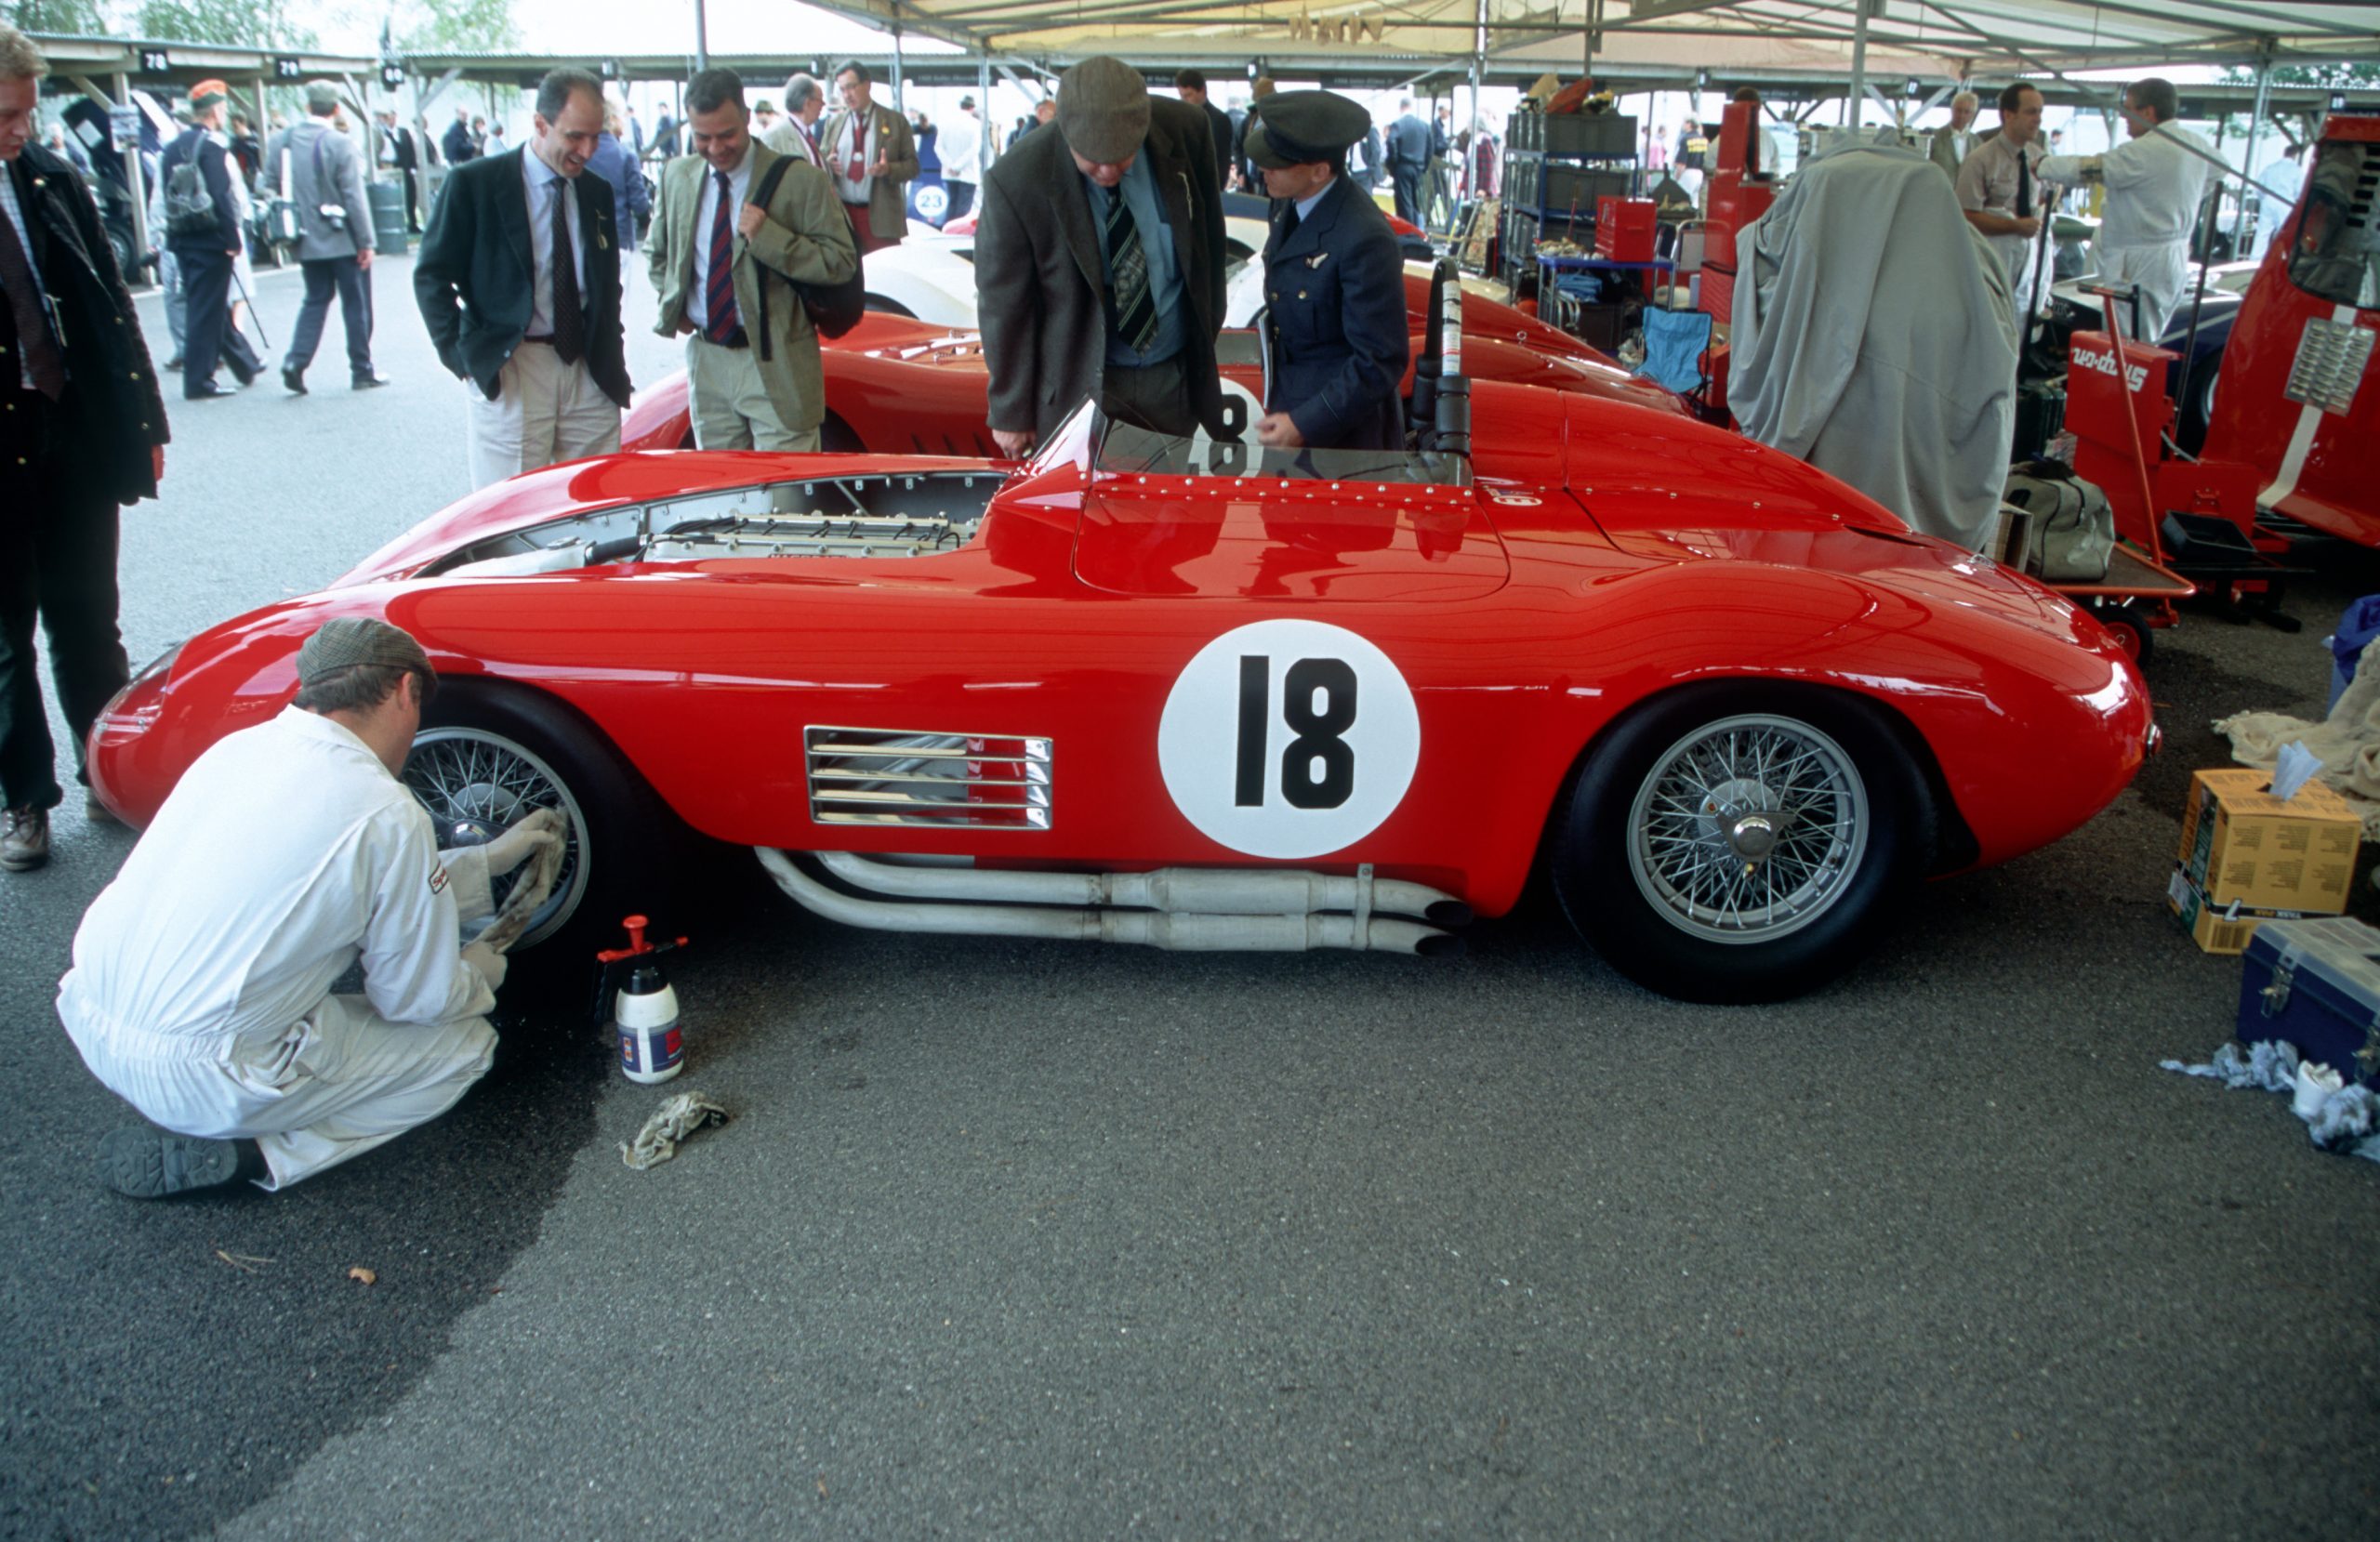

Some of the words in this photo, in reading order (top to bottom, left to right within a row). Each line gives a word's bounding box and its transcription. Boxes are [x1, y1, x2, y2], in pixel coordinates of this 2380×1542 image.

[920, 194, 942, 207] 23
[1189, 394, 1248, 477] 8
[1235, 655, 1357, 810] 18
[2224, 899, 2241, 921] 7
